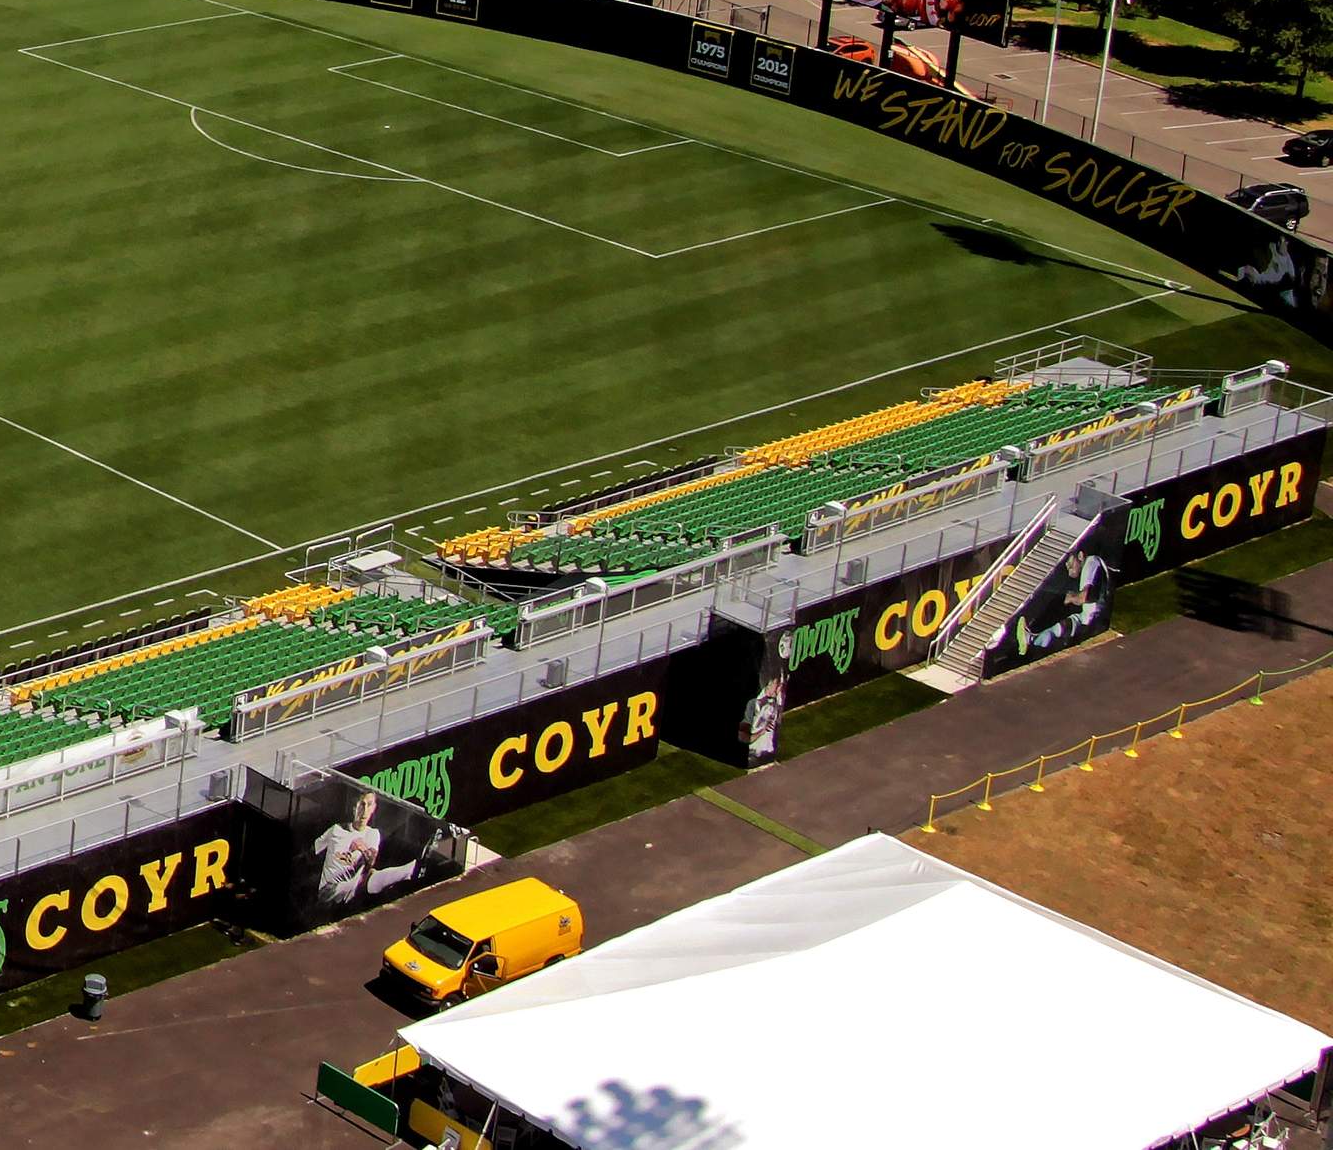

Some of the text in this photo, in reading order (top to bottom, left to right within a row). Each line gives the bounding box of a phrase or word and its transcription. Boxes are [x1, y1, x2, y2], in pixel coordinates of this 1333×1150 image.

[696, 40, 725, 59] 1975
[756, 57, 789, 77] 2012
[833, 69, 1196, 233] WE STAND FOR SOCCER
[1180, 461, 1302, 540] COYR
[488, 691, 657, 790] COYR
[24, 838, 231, 952] COYR
